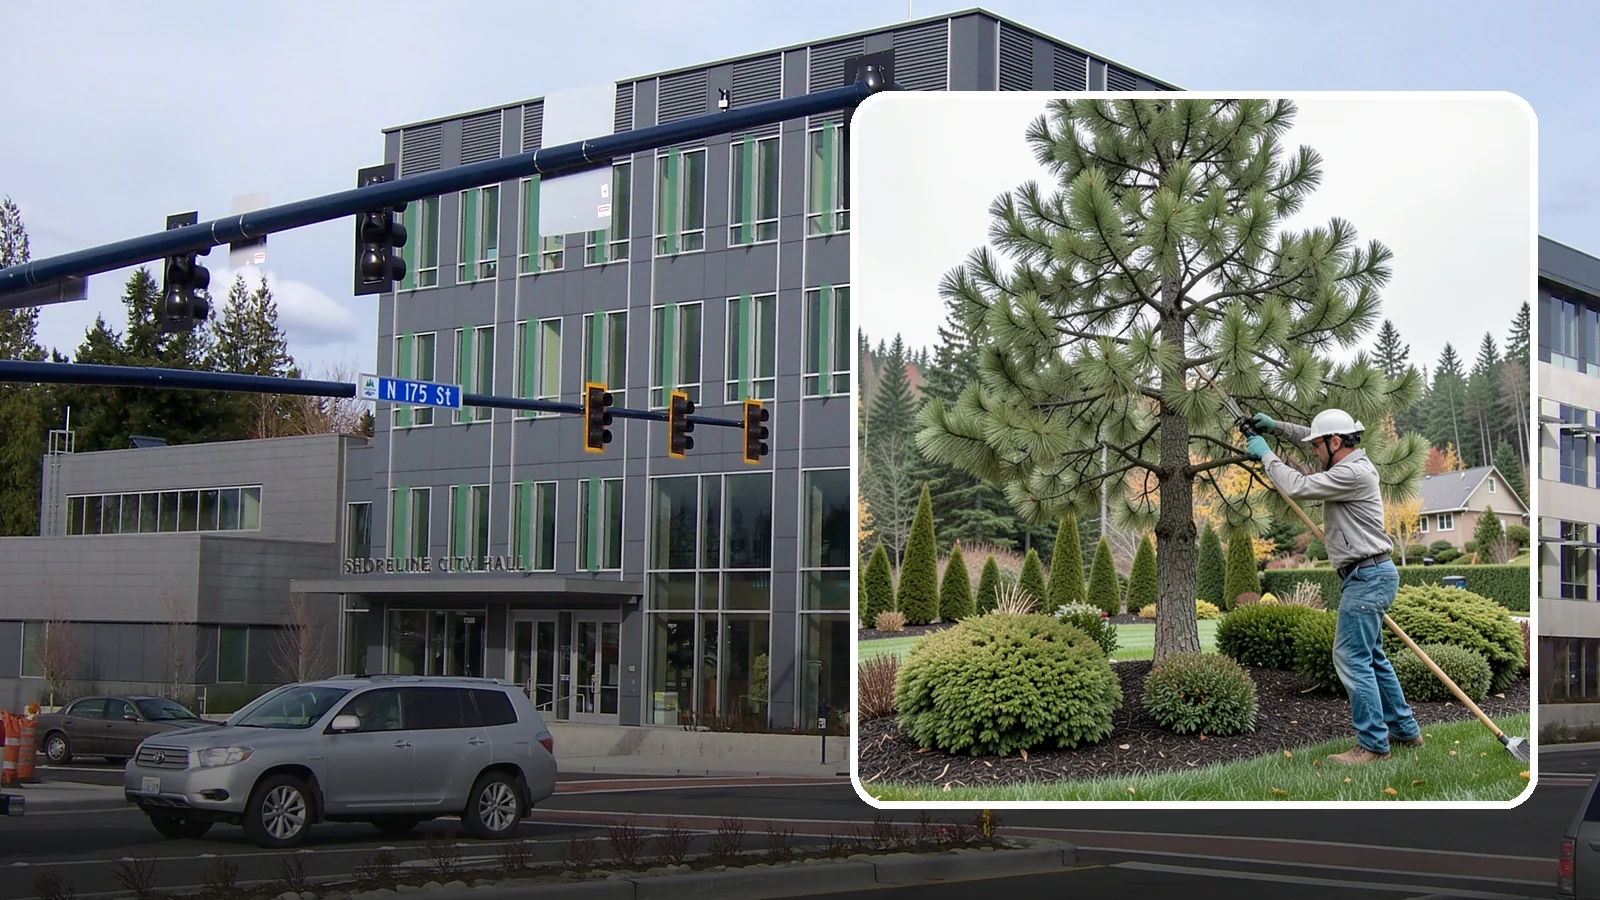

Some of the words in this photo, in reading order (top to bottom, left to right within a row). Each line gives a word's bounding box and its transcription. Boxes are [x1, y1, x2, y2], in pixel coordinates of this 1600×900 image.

[387, 380, 396, 400] N
[405, 382, 427, 403] 175
[436, 386, 451, 406] St
[344, 556, 432, 574] SHORELINE
[438, 556, 475, 573] CITY
[485, 555, 525, 573] HALL
